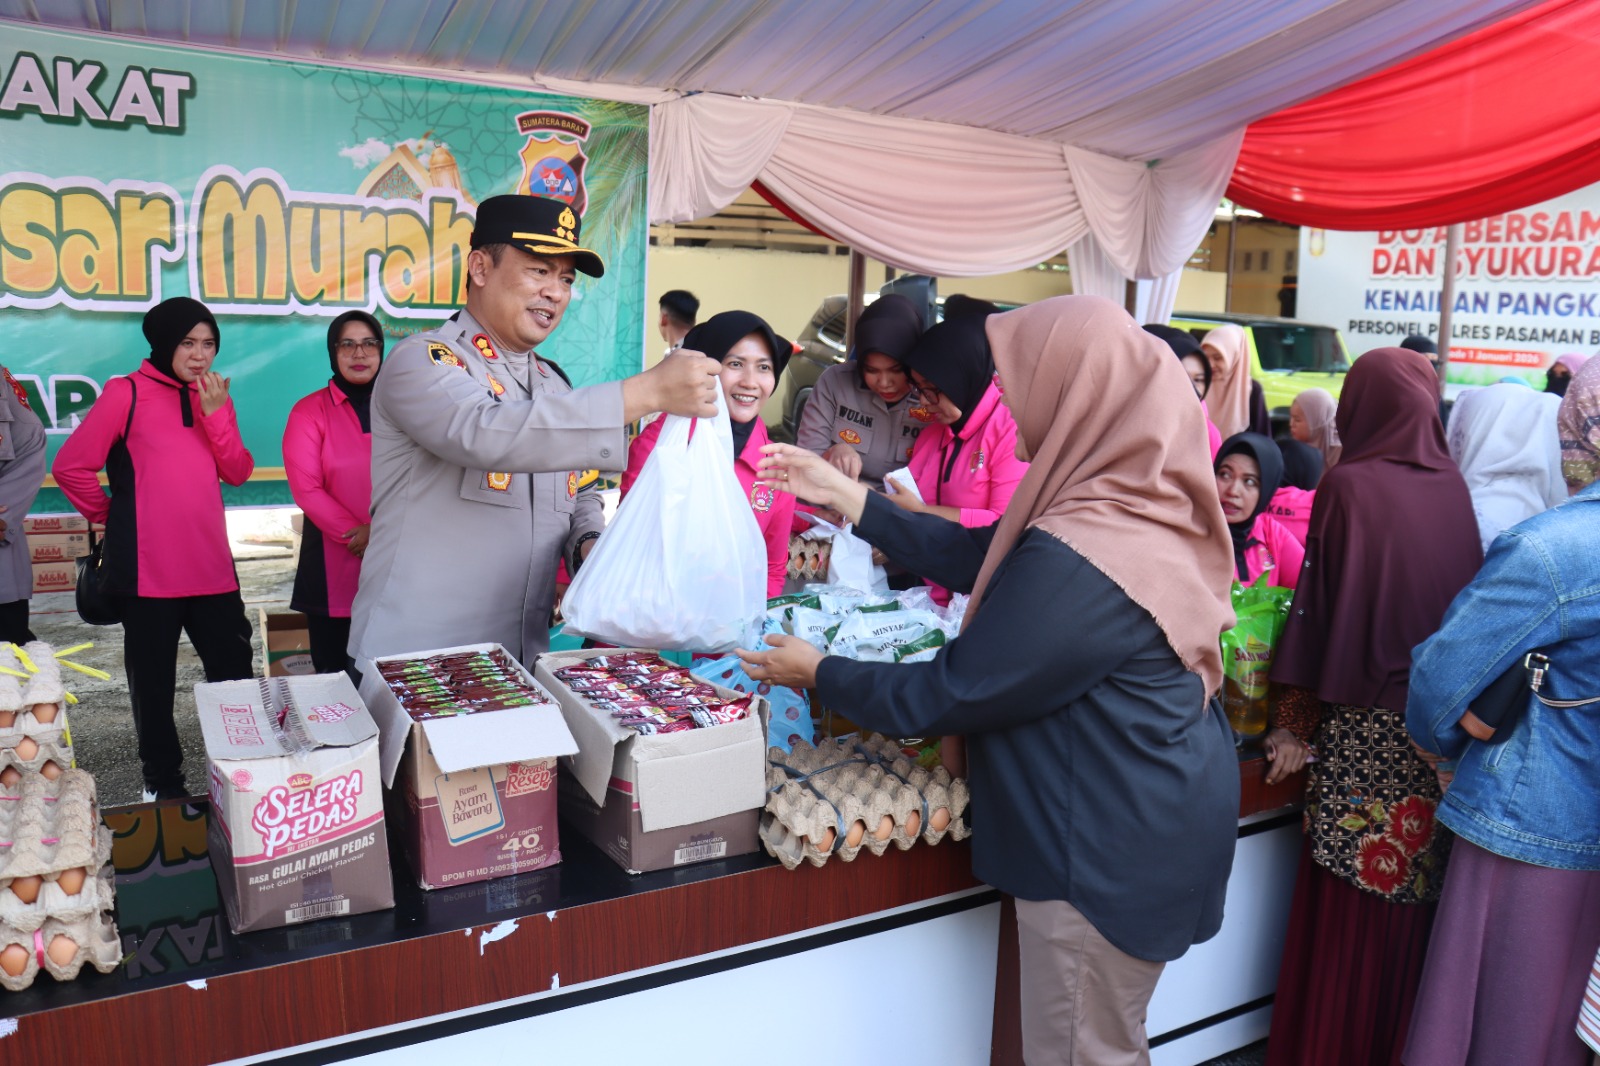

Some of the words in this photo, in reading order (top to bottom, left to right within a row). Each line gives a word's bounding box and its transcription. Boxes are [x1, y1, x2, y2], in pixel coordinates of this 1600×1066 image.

[522, 117, 560, 128] SUMATERA
[561, 119, 584, 134] BARAT
[202, 178, 475, 305] Murah
[1373, 248, 1435, 275] DAN
[1365, 289, 1489, 314] KENAIAN
[1349, 319, 1422, 335] PERSONEL
[1428, 323, 1490, 340] PLRES
[1496, 326, 1584, 344] PASAMAN
[838, 405, 873, 428] WULAN
[35, 547, 62, 556] M&M
[38, 572, 67, 582] M&M
[872, 624, 904, 637] MINYAK
[519, 762, 546, 775] Kreasi
[291, 778, 310, 786] ABC
[459, 784, 478, 796] Rasa
[507, 771, 549, 791] Resep
[263, 772, 361, 826] SELERA
[454, 792, 488, 812] Ayam
[452, 802, 493, 825] Bawang
[265, 797, 355, 857] PEDAS
[501, 833, 540, 851] 40
[249, 873, 270, 885] RASA
[272, 858, 307, 880] GULAI
[308, 847, 340, 869] AYAM
[341, 832, 376, 857] PEDAS
[259, 883, 275, 892] Hot
[276, 875, 299, 887] Gulai
[300, 864, 333, 880] Chicken
[334, 852, 366, 868] Flavour
[442, 871, 465, 882] BPOM
[476, 867, 488, 876] MD
[312, 894, 345, 904] BUNGKUS
